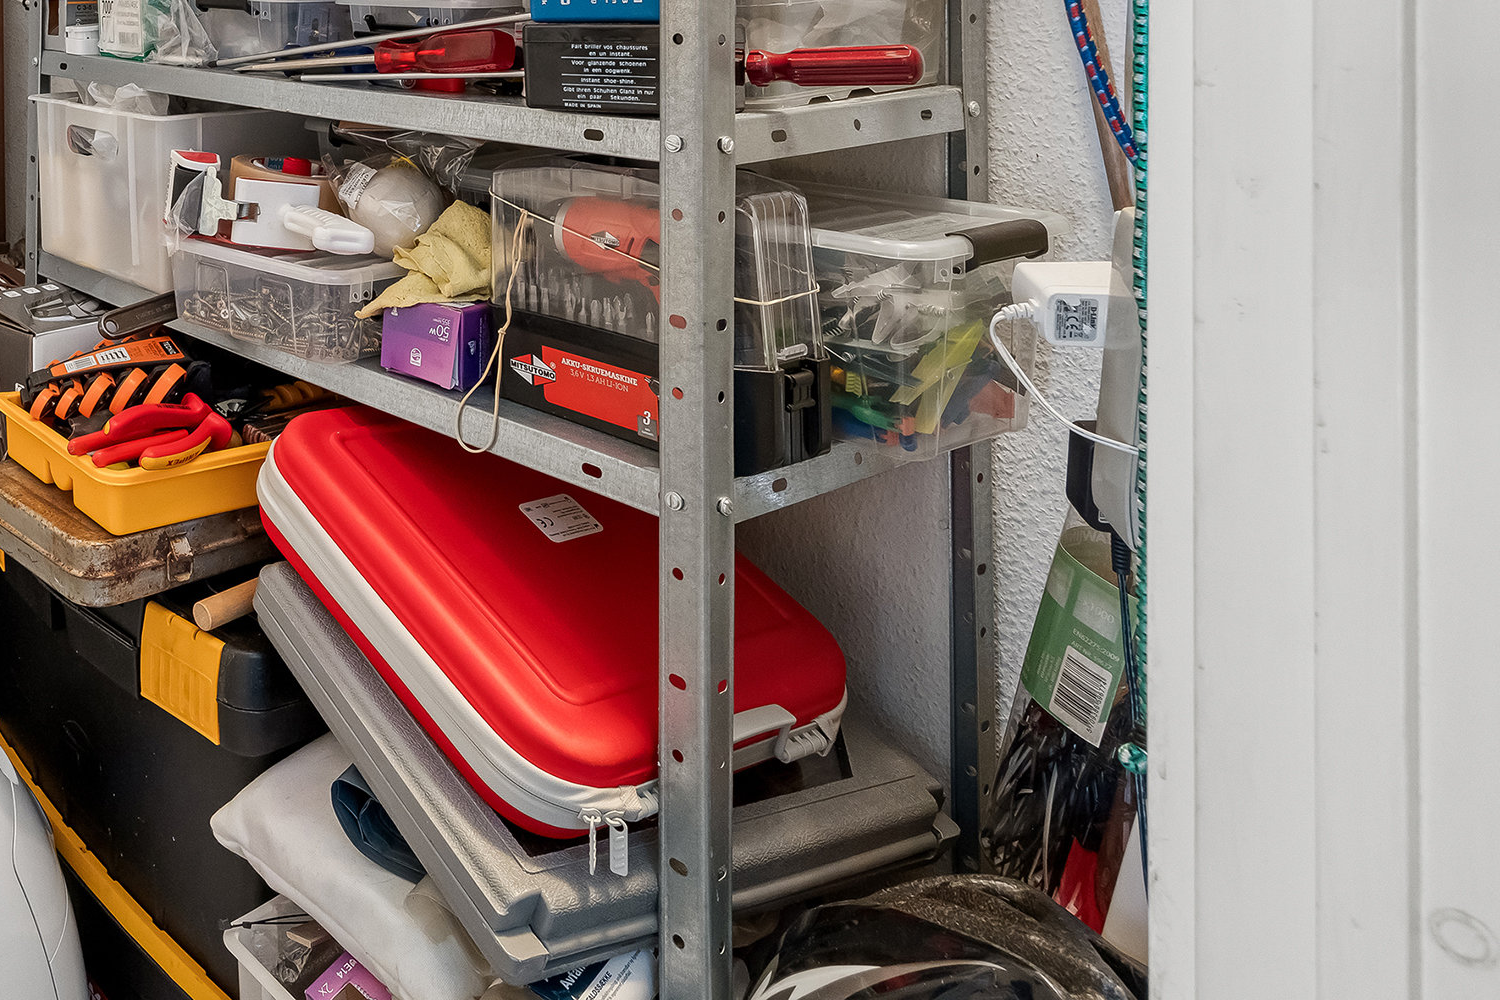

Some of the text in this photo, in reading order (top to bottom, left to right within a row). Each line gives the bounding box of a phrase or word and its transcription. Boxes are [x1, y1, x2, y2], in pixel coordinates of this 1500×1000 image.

[510, 360, 556, 380] MITSUTOMO
[561, 357, 638, 387] AKKU-SKRUEMASKINE
[579, 371, 585, 379] V
[595, 375, 606, 386] AH
[606, 378, 629, 392] LI-ION
[642, 410, 652, 426] 3
[317, 982, 334, 997] 2x
